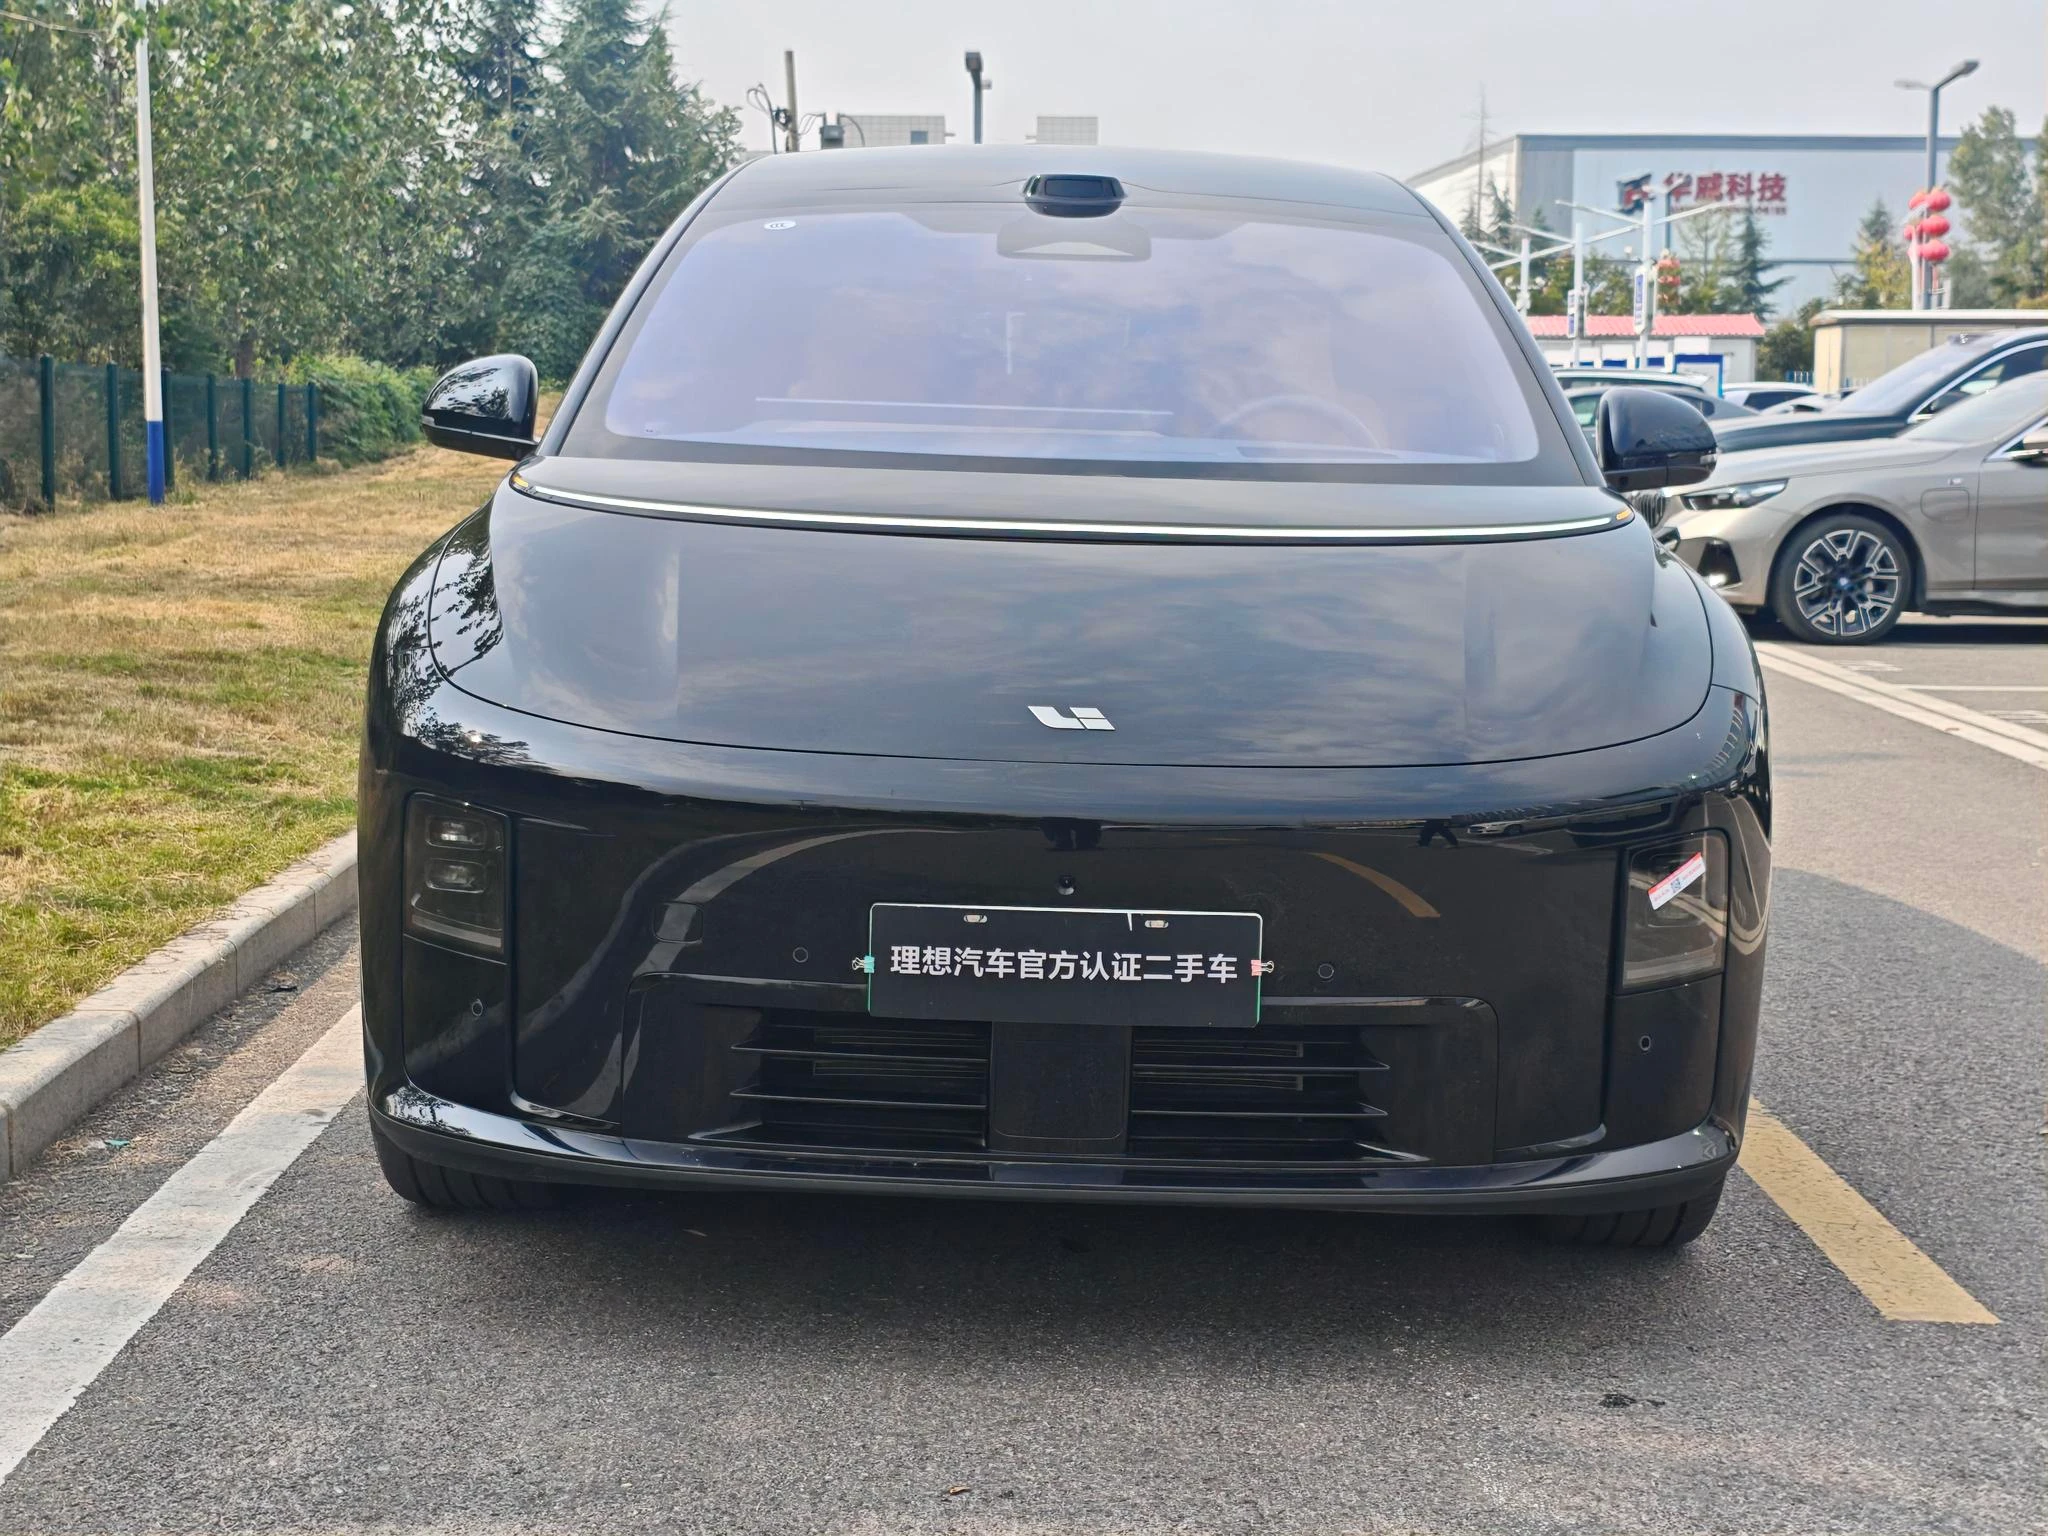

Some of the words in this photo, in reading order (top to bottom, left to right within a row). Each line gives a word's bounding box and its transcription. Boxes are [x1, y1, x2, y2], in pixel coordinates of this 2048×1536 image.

[890, 945, 1238, 984] 理想汽车官方认证二手车
